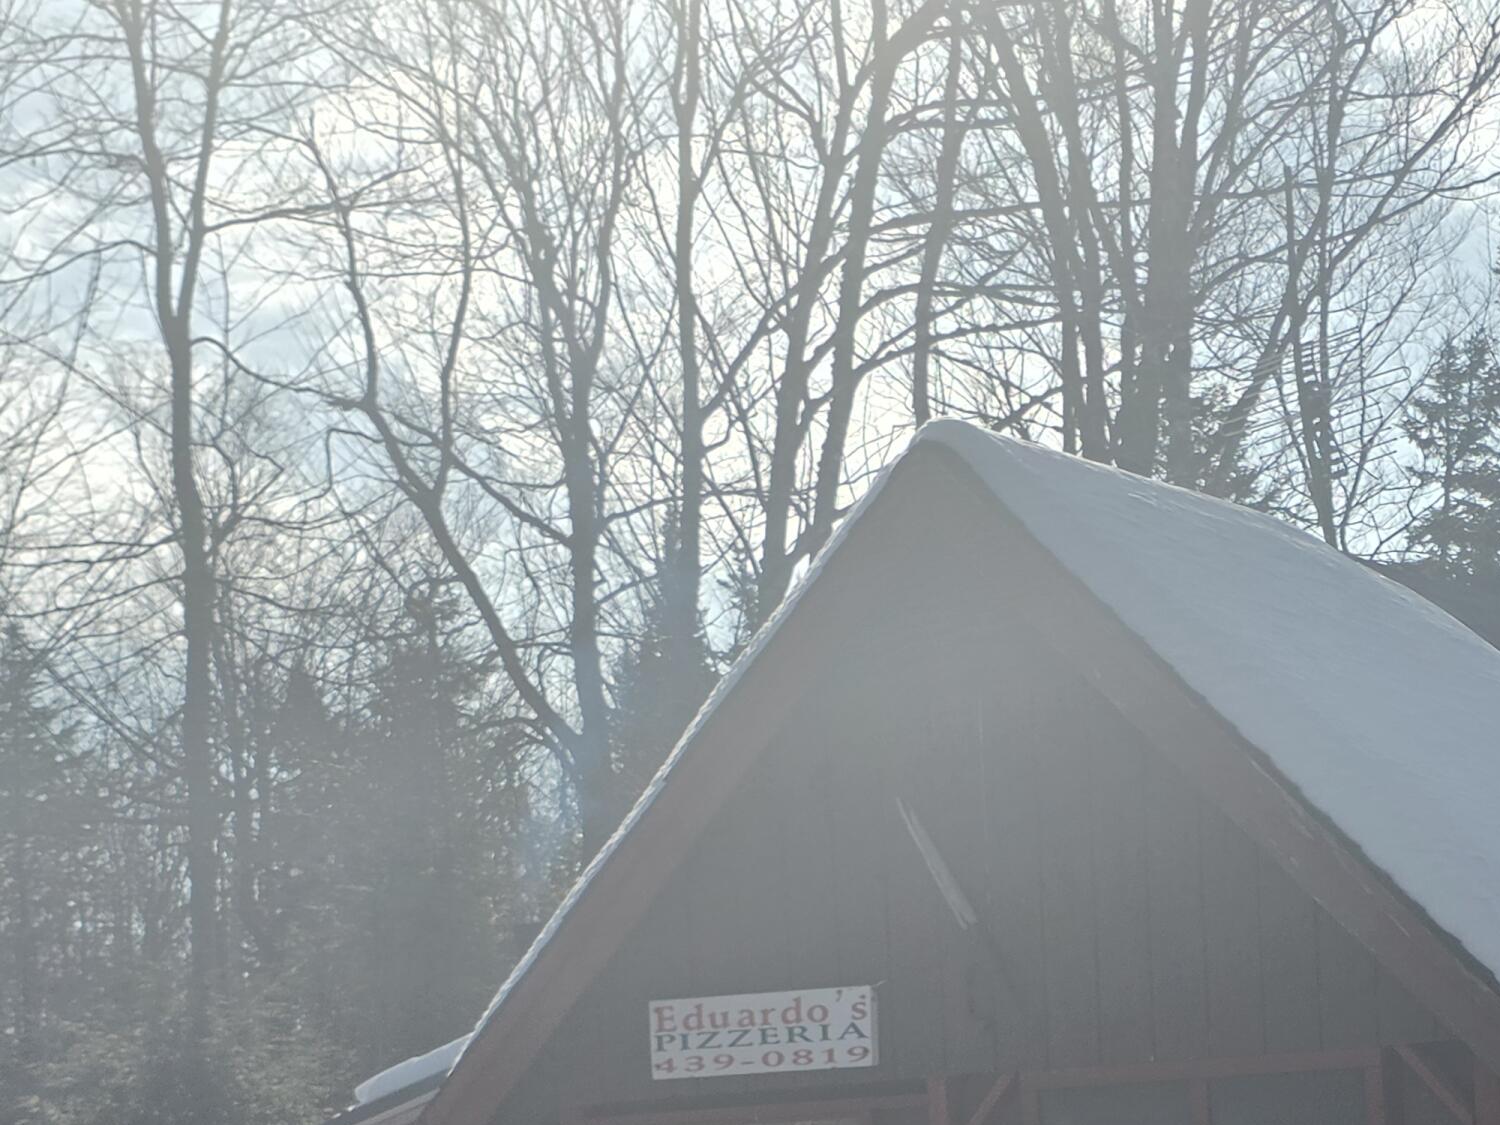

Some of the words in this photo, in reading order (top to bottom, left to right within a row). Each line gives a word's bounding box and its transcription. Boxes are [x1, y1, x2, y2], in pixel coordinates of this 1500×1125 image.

[653, 989, 868, 1033] Eduardo's
[654, 1022, 870, 1052] PIZZERIA
[654, 1046, 870, 1074] 439-0819
